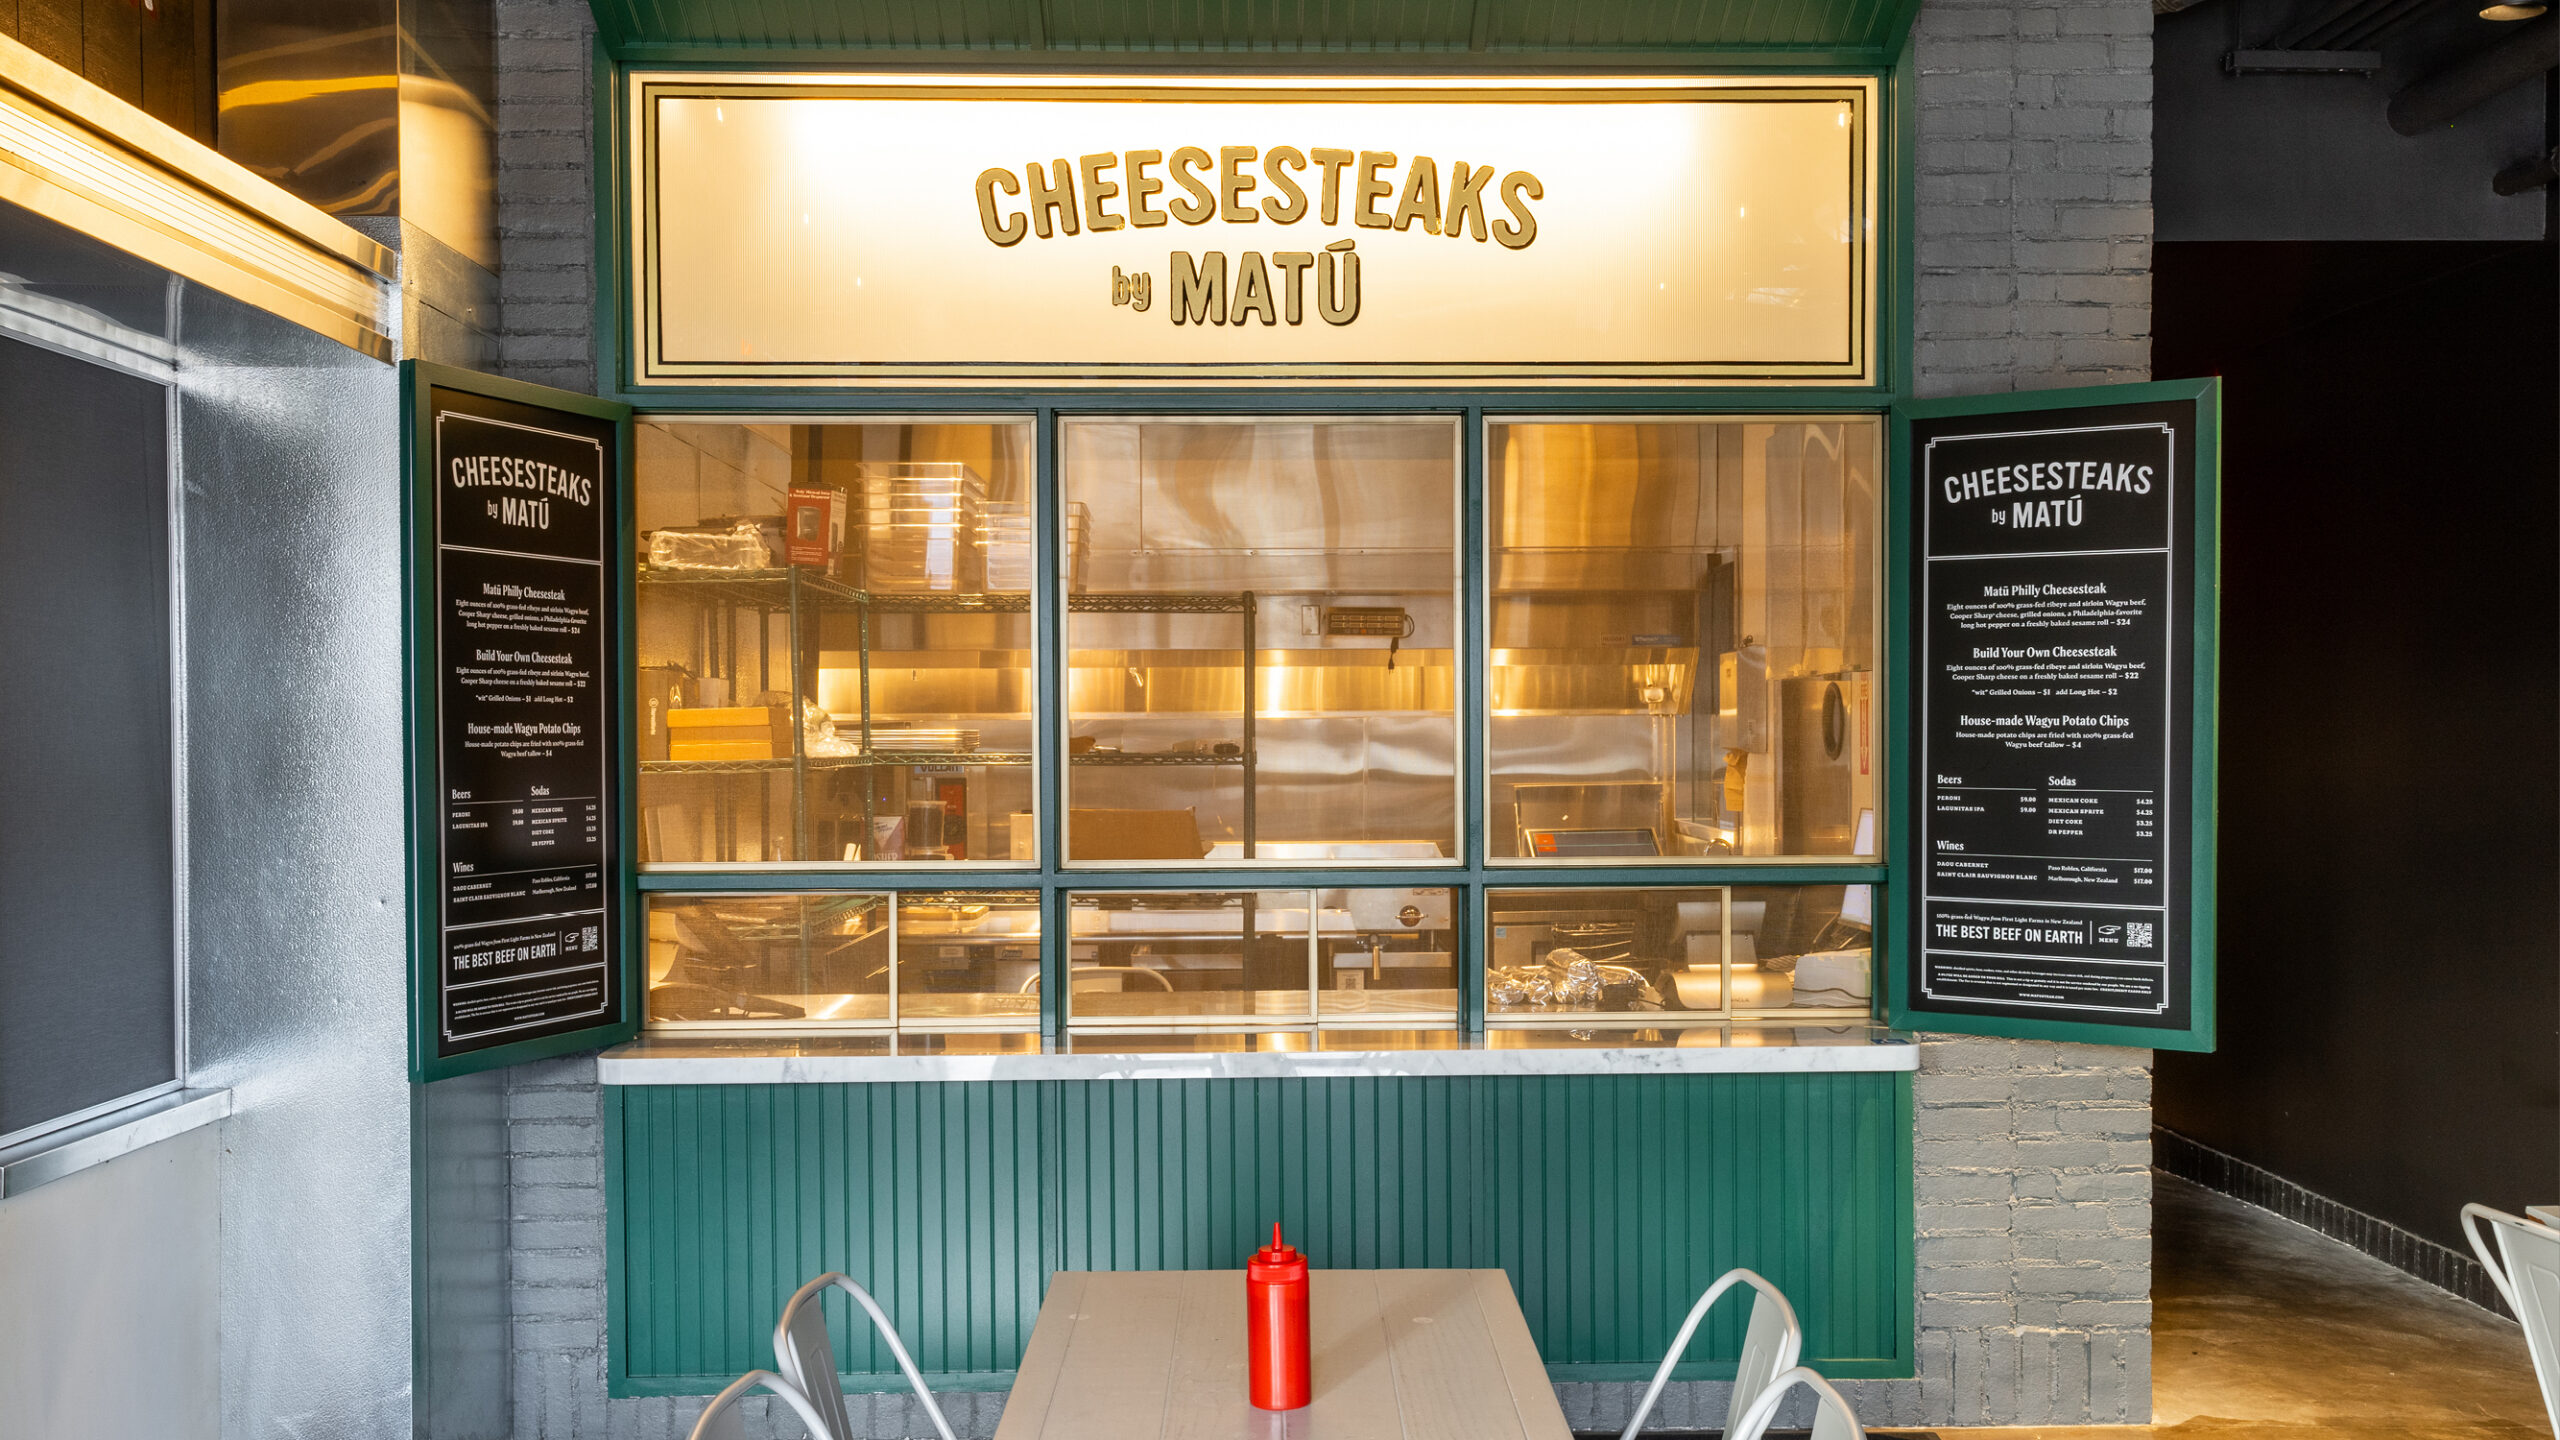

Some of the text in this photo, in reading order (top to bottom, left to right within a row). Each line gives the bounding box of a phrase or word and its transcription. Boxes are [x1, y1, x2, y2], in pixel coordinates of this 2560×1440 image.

[975, 146, 1544, 250] CHEESESTEAKS
[1111, 265, 1152, 312] by
[452, 456, 591, 506] CHEESESTEAKS
[1944, 461, 2153, 504] CHEESESTEAKS
[487, 499, 498, 519] by
[1991, 508, 2006, 525] by
[502, 584, 523, 600] Philly
[523, 586, 566, 601] Cheesesteak
[2011, 584, 2041, 598] Philly
[2042, 582, 2107, 595] Cheesesteak
[1947, 603, 1964, 612] Eight
[2015, 601, 2046, 610] grass-fed
[2046, 601, 2068, 609] ribeye
[2105, 599, 2129, 608] Wagyu
[1949, 613, 1973, 621] Cooper
[2020, 611, 2042, 619] grilled
[1960, 622, 1975, 630] long
[2026, 620, 2050, 628] freshly
[2050, 619, 2071, 627] baked
[2116, 618, 2131, 626] $24
[476, 649, 573, 664] Build Your Own Cheesesteak
[1973, 645, 2117, 658] Build Your Own Cheesesteak
[1946, 664, 1963, 672] Eight
[2015, 663, 2045, 672] grass-fed
[2046, 663, 2067, 671] ribeye
[2081, 662, 2103, 670] sirloin
[2104, 662, 2128, 671] Wagyu
[1952, 673, 1975, 682] Cooper
[1976, 673, 1996, 681] Sharp
[2034, 673, 2058, 681] freshly
[2043, 688, 2051, 696] $1
[2069, 688, 2087, 697] Long
[2108, 688, 2118, 696] $2
[1960, 714, 2129, 729] House-made Wagyu Potato Chips
[468, 722, 581, 737] House-made Wagyu Potato Chips
[1996, 732, 2017, 740] potato
[2018, 731, 2036, 740] chips
[2048, 731, 2065, 739] fried
[2102, 732, 2134, 740] grass-fed
[2005, 741, 2028, 749] Wagyu
[2072, 741, 2082, 749] $4
[1937, 774, 1962, 784] Beers
[2048, 775, 2077, 786] Sodas
[452, 789, 471, 800] Beers
[531, 785, 550, 796] Sodas
[1936, 840, 1964, 851] Wines
[452, 862, 474, 873] Wines
[1935, 924, 2083, 944] THE BEST BEEF ON EARTH
[453, 943, 556, 970] THE BEST BEEF ON EARTH
